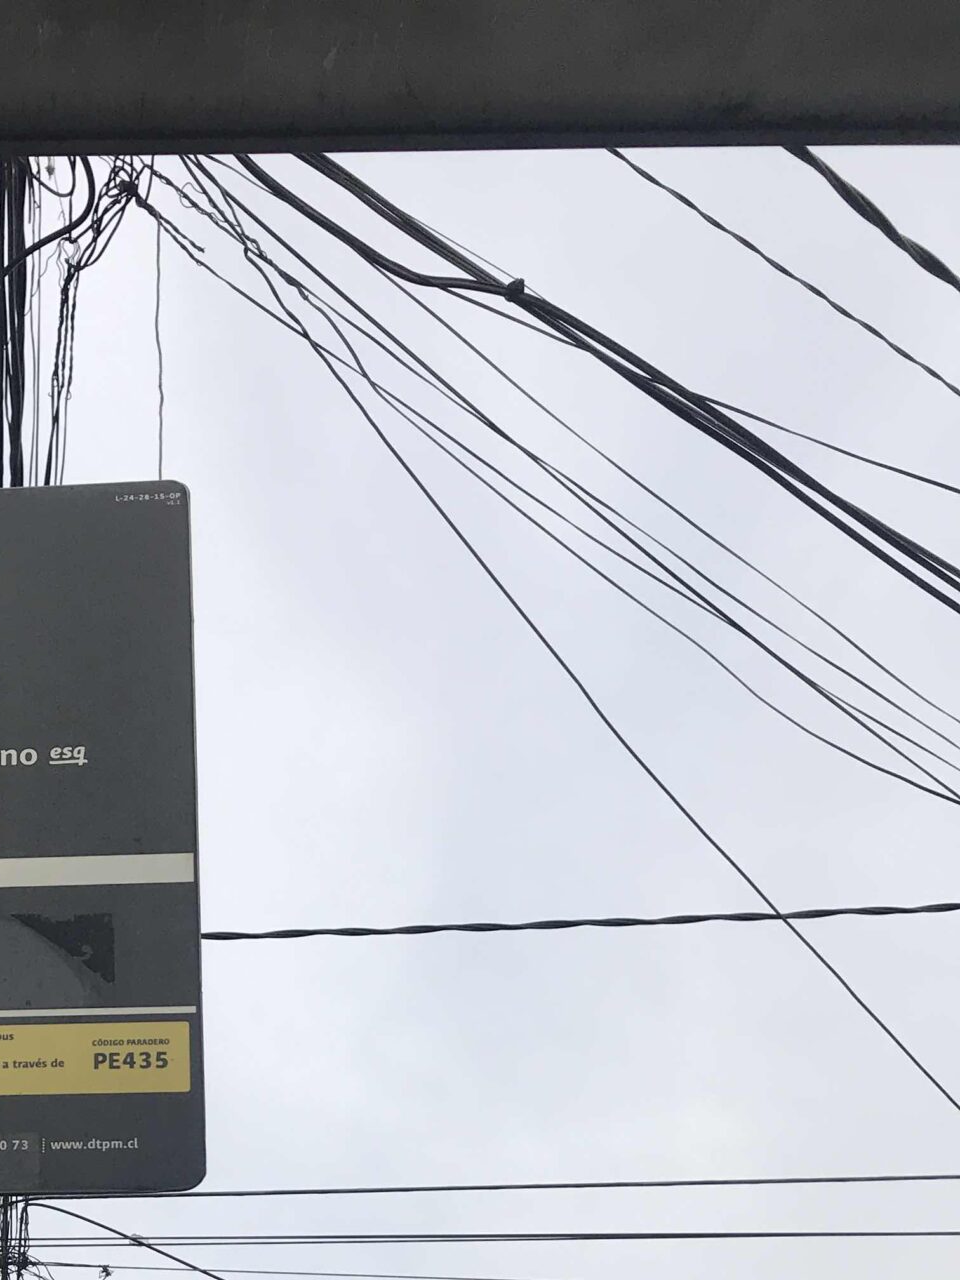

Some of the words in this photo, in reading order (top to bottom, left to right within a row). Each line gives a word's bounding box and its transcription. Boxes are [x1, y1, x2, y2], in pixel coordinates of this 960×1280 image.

[49, 744, 88, 766] esq
[92, 1037, 125, 1047] CÓDIGO
[126, 1038, 170, 1046] PARADERO
[2, 1061, 9, 1069] a
[12, 1058, 47, 1069] través
[50, 1058, 65, 1068] de
[93, 1051, 169, 1070] PE435
[12, 1139, 29, 1150] 73
[50, 1137, 139, 1152] www.dtpm.cl
